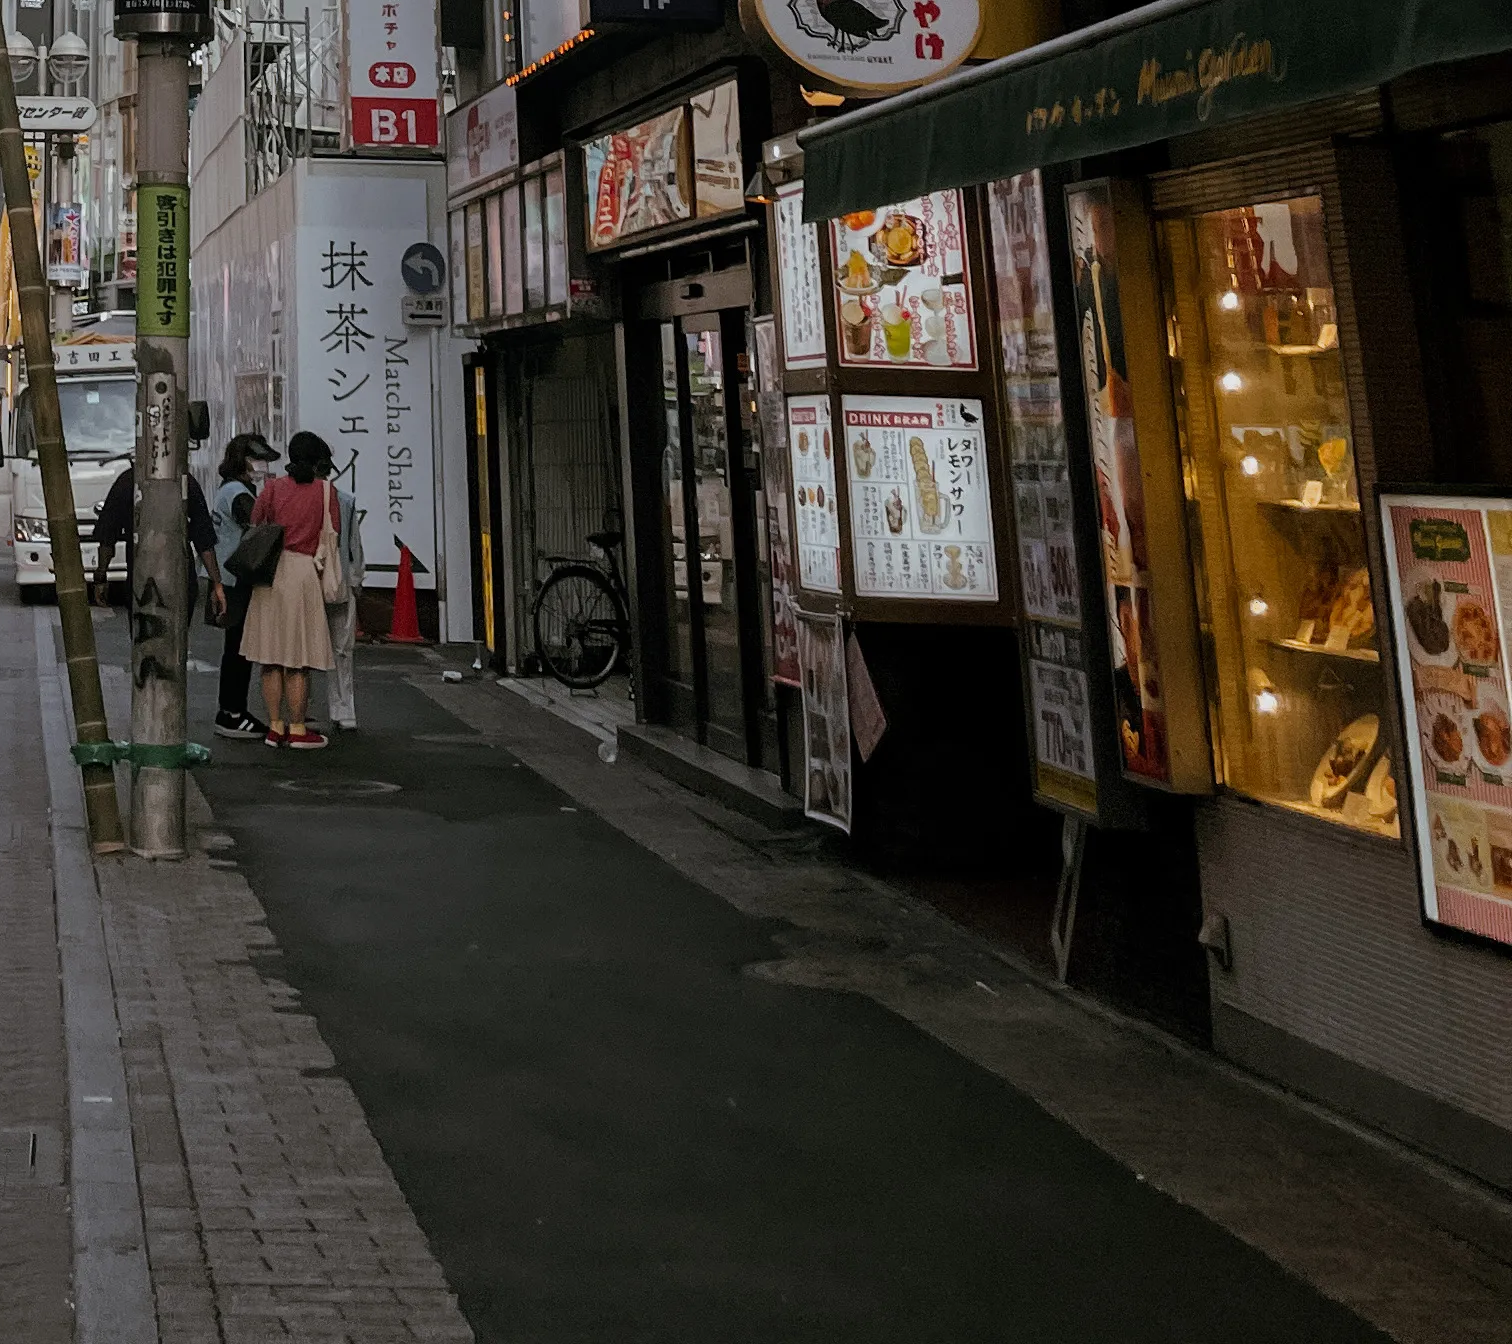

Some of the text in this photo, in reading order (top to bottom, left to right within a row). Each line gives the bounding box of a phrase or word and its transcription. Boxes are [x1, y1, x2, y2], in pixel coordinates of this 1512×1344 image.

[19, 105, 89, 120] センター街
[370, 110, 417, 143] B1
[156, 194, 177, 326] 客引きは犯罪です
[384, 337, 413, 524] Matcha Shake
[849, 413, 891, 426] DRINK
[961, 439, 973, 485] タワー
[947, 438, 965, 534] レモンサワー
